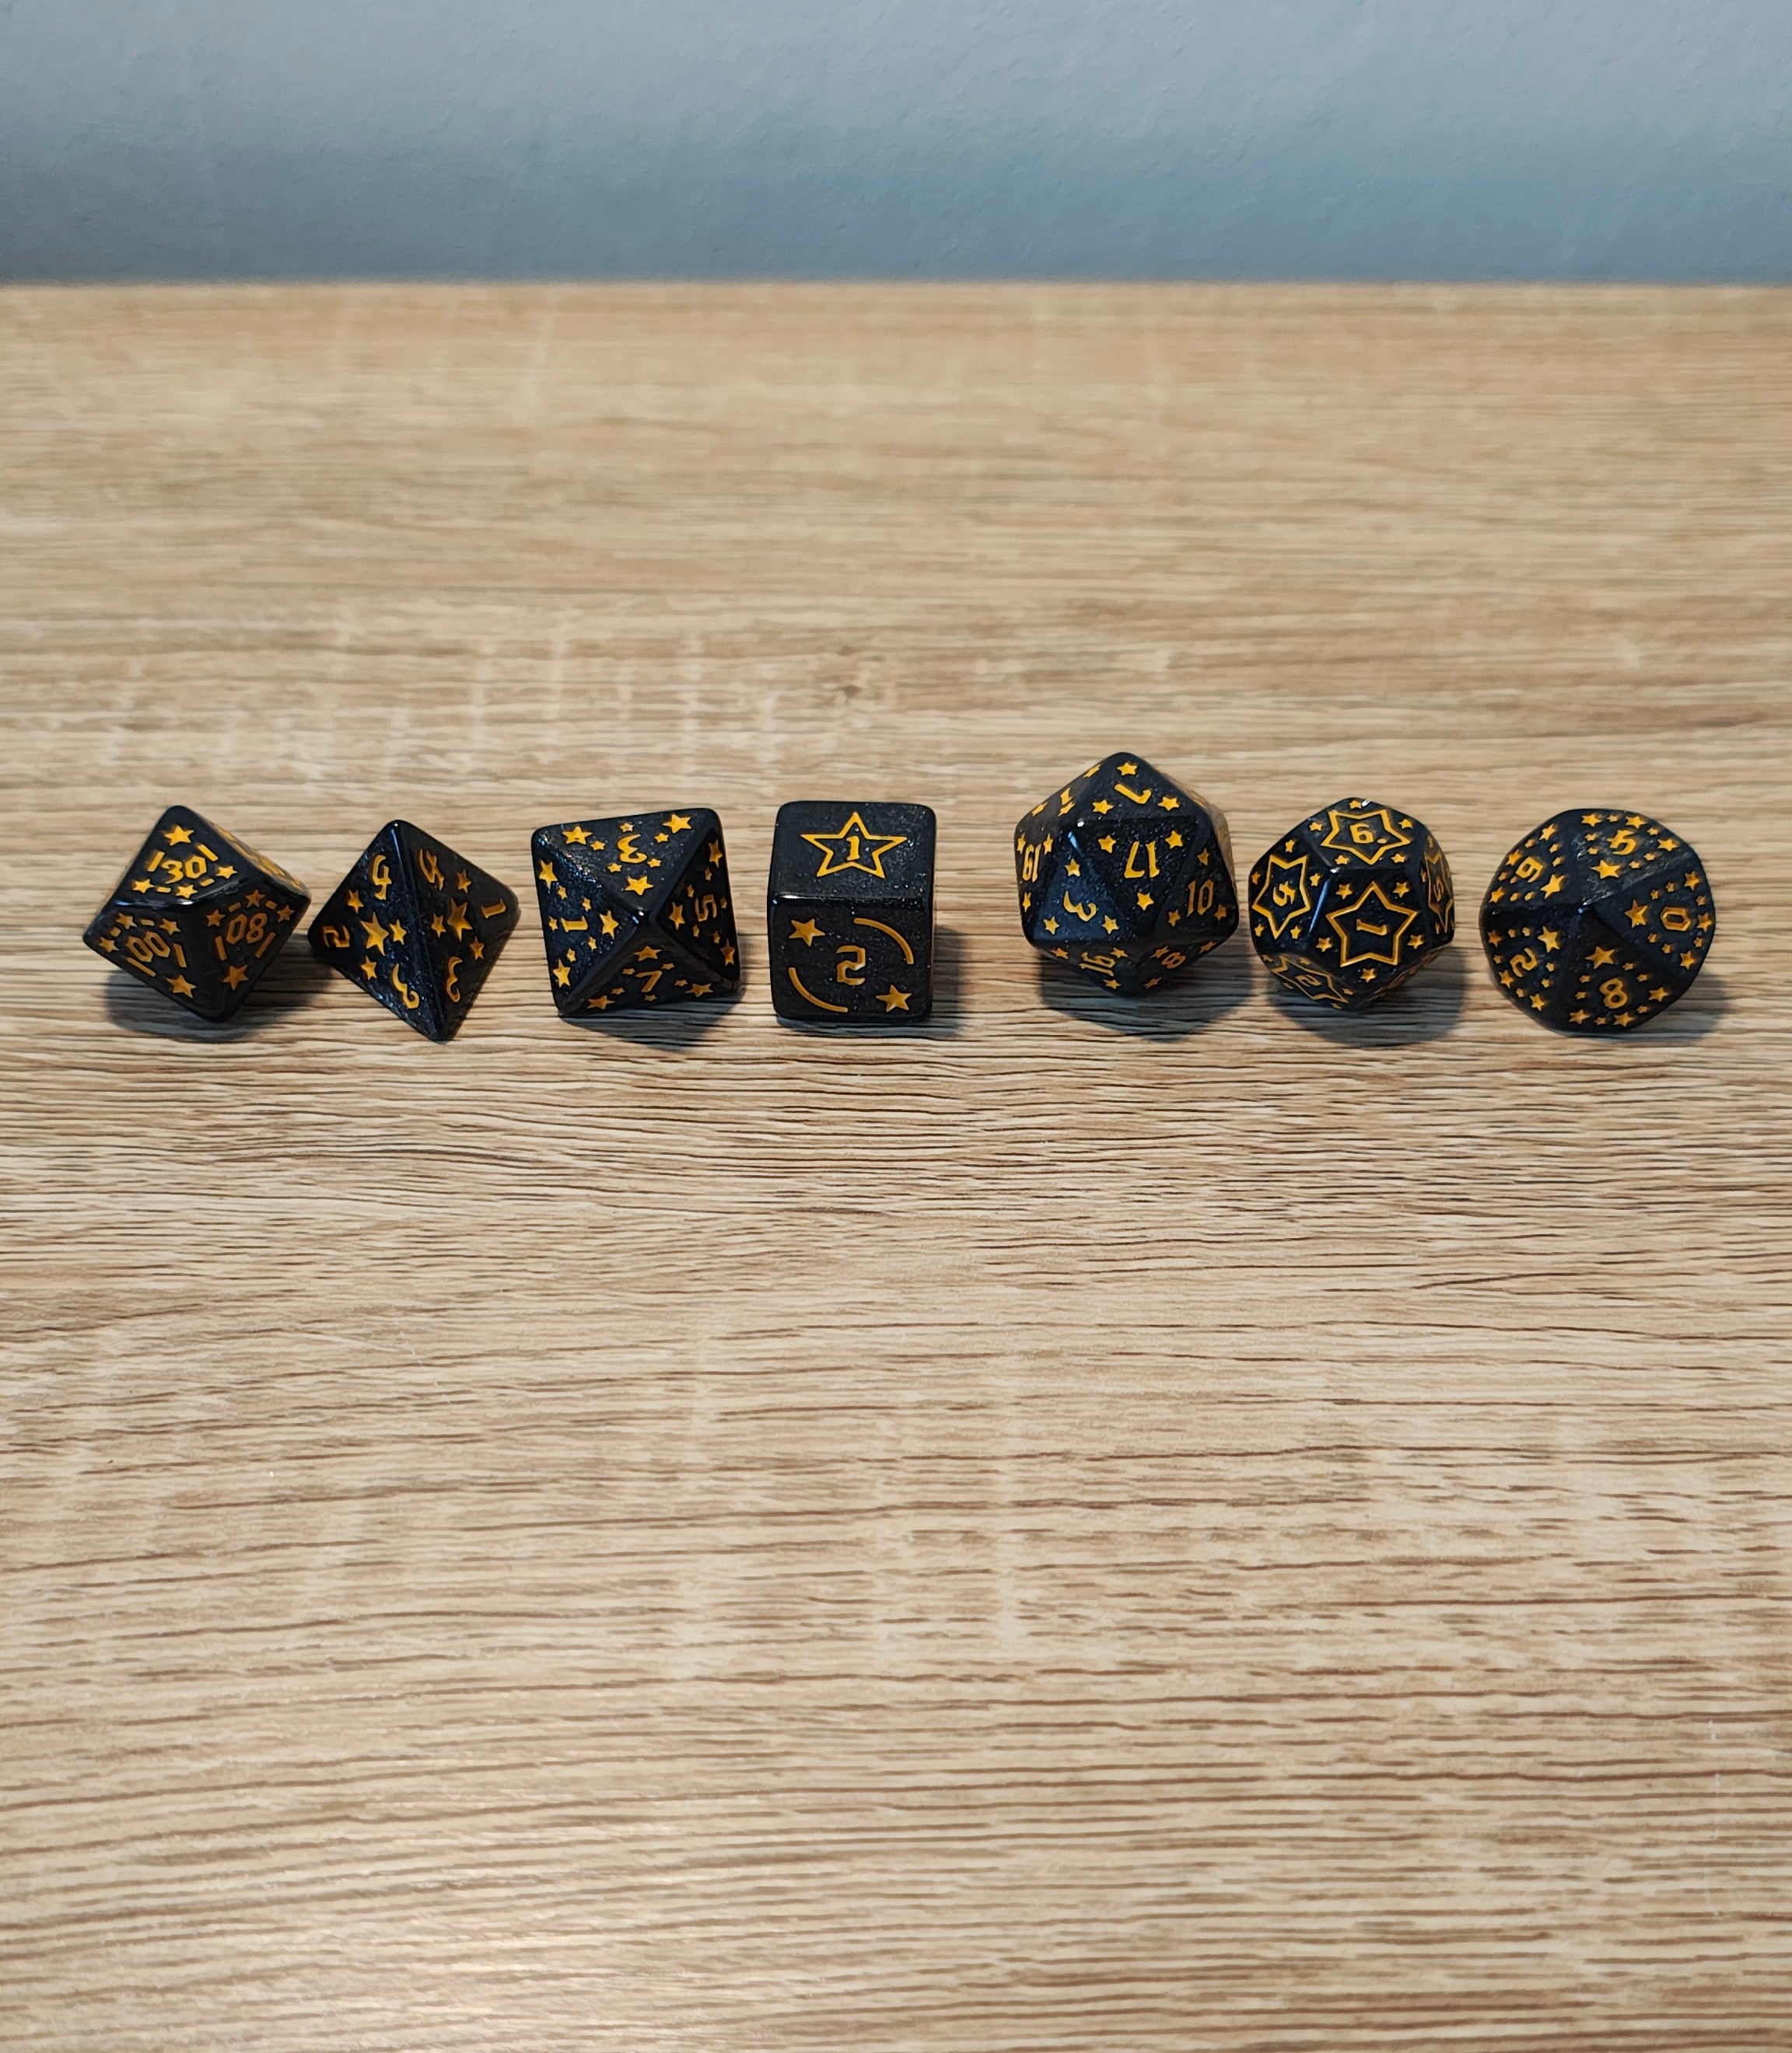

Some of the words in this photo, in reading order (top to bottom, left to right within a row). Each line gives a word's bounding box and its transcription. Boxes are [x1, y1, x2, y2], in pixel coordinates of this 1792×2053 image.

[1114, 782, 1152, 805] 7
[617, 834, 648, 864] 3
[845, 835, 861, 861] 1
[160, 855, 208, 884] 30
[1062, 890, 1097, 922] 3
[1186, 879, 1215, 917] 10
[560, 916, 589, 933] 1
[1356, 918, 1388, 936] 1
[1660, 906, 1692, 932] 0
[125, 930, 171, 964] 00
[836, 945, 866, 986] 2
[635, 970, 663, 993] 7
[1598, 977, 1629, 1009] 8
